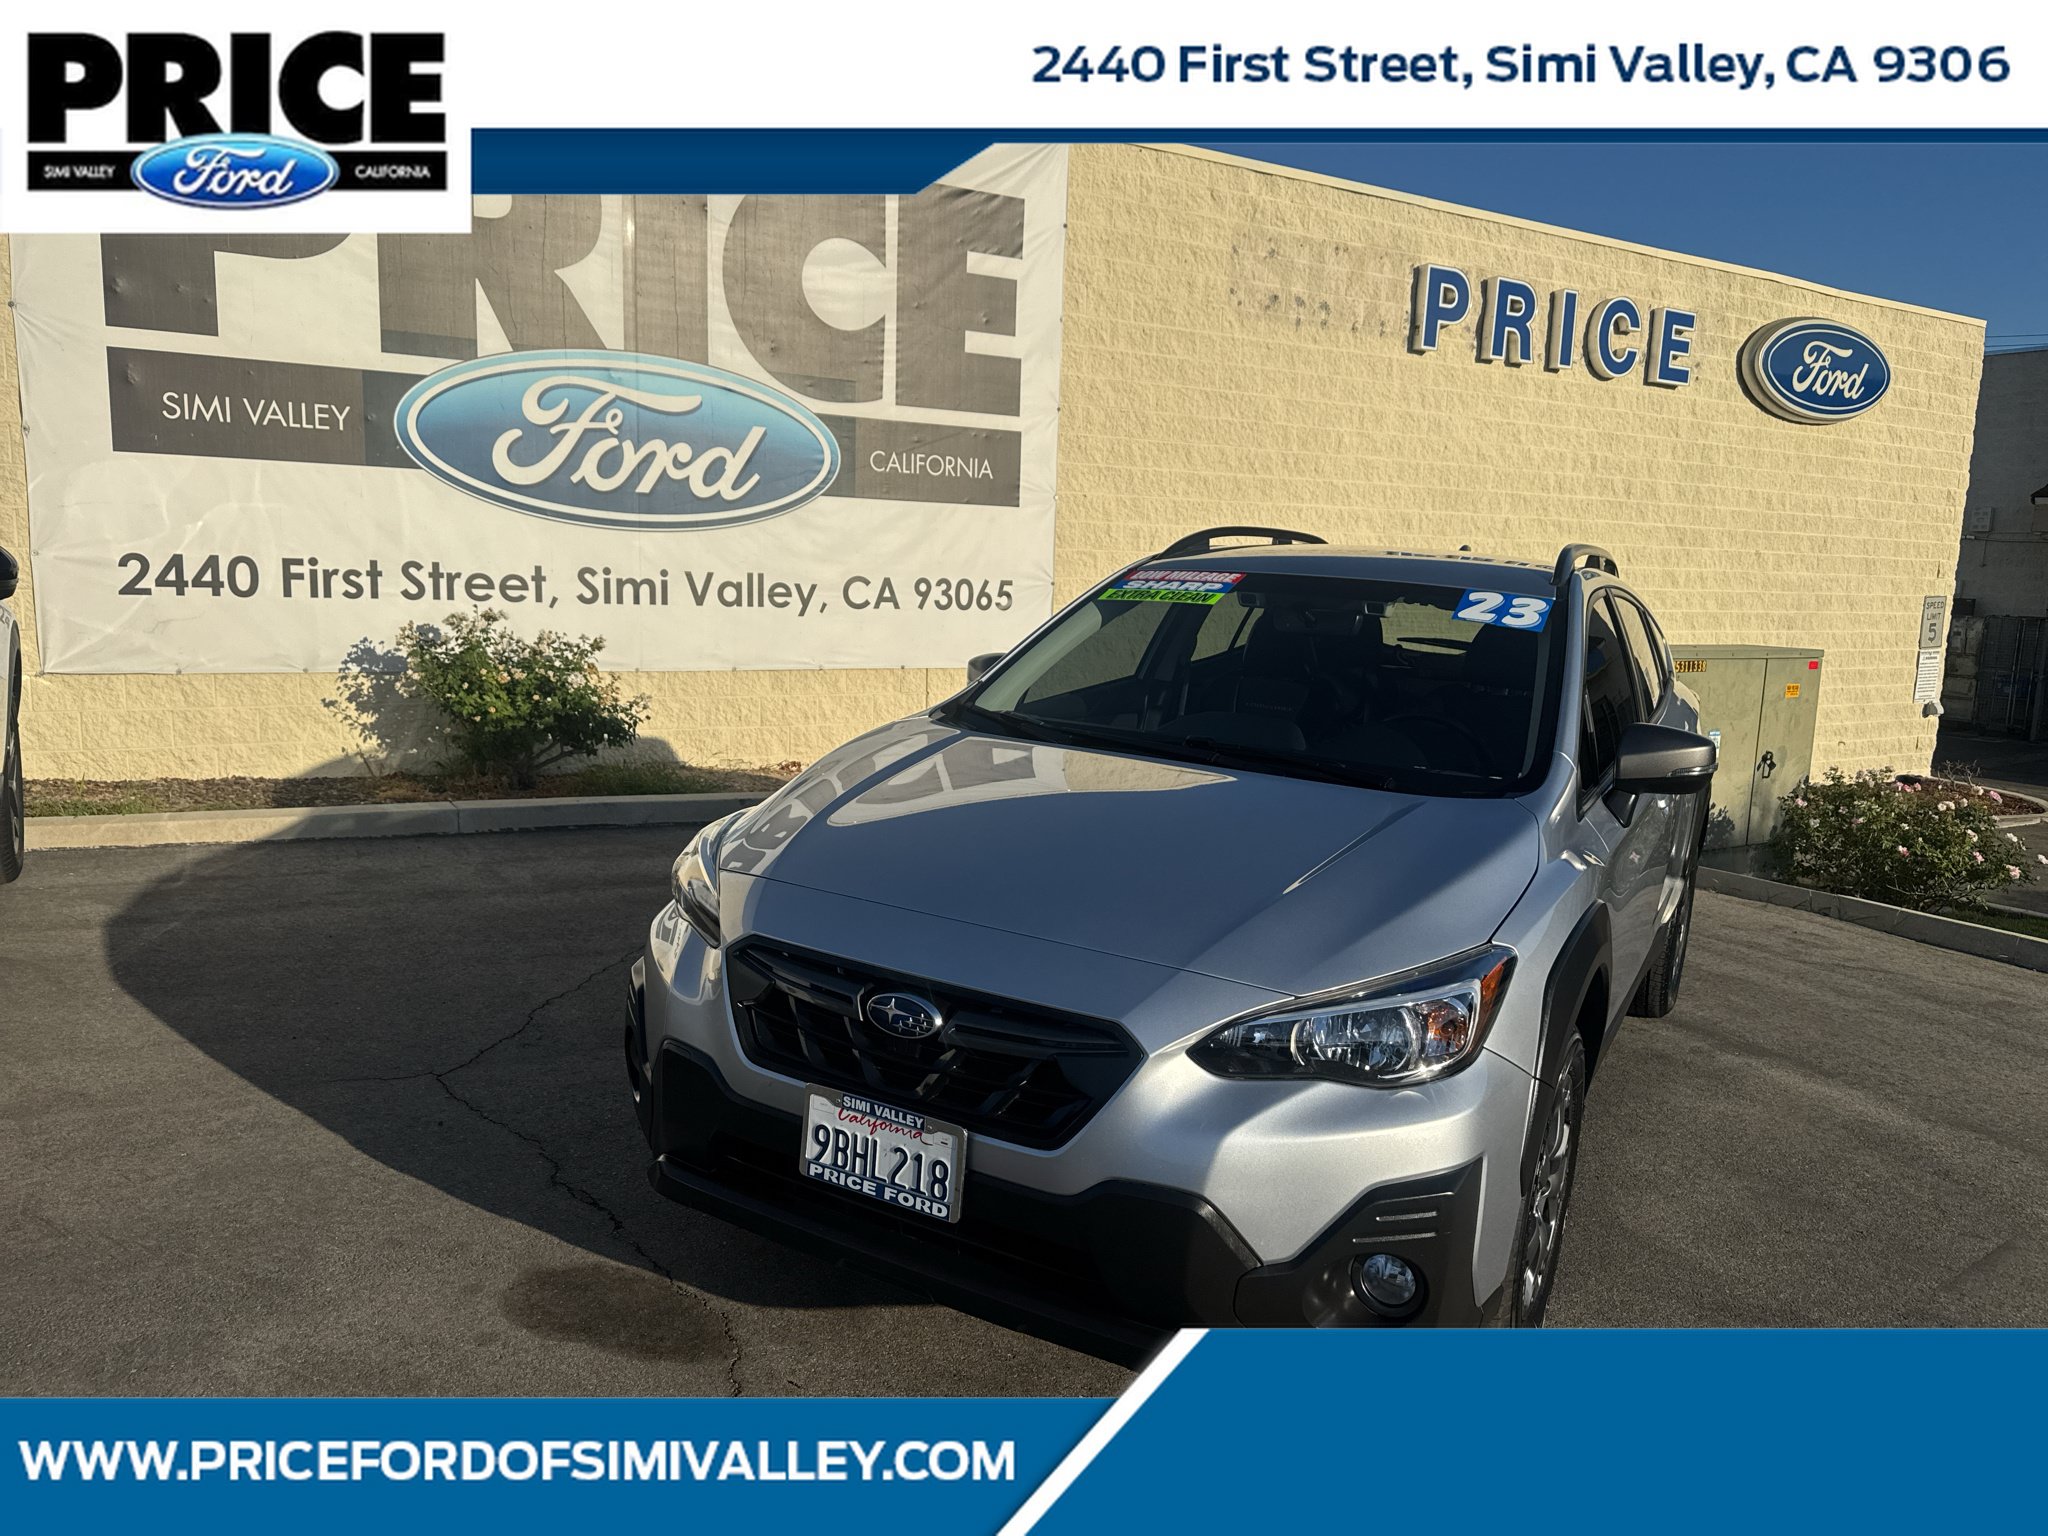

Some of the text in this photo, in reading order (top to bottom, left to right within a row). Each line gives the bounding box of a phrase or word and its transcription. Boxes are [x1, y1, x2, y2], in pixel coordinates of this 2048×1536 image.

[1410, 263, 1697, 388] PRICE
[1791, 340, 1868, 401] Ford
[161, 391, 352, 432] SIMI VALLEY
[491, 375, 768, 502] Ford
[868, 450, 995, 480] CALIFORNIA
[116, 552, 1013, 617] 2440 First Street, Simi Valley, CA 93065
[1122, 580, 1224, 592] SHARP
[1130, 570, 1241, 583] LOW MILEAGE
[1106, 589, 1216, 603] EXTRA CLEAN
[1457, 591, 1550, 628] 23
[1926, 601, 1944, 610] SPEED
[1926, 612, 1942, 621] LIMIT
[1928, 623, 1937, 642] 5
[837, 1107, 934, 1146] California
[842, 1095, 925, 1129] SIMI VALLEY
[814, 1123, 949, 1203] 9BHL218
[809, 1163, 948, 1218] PRICE FORD
